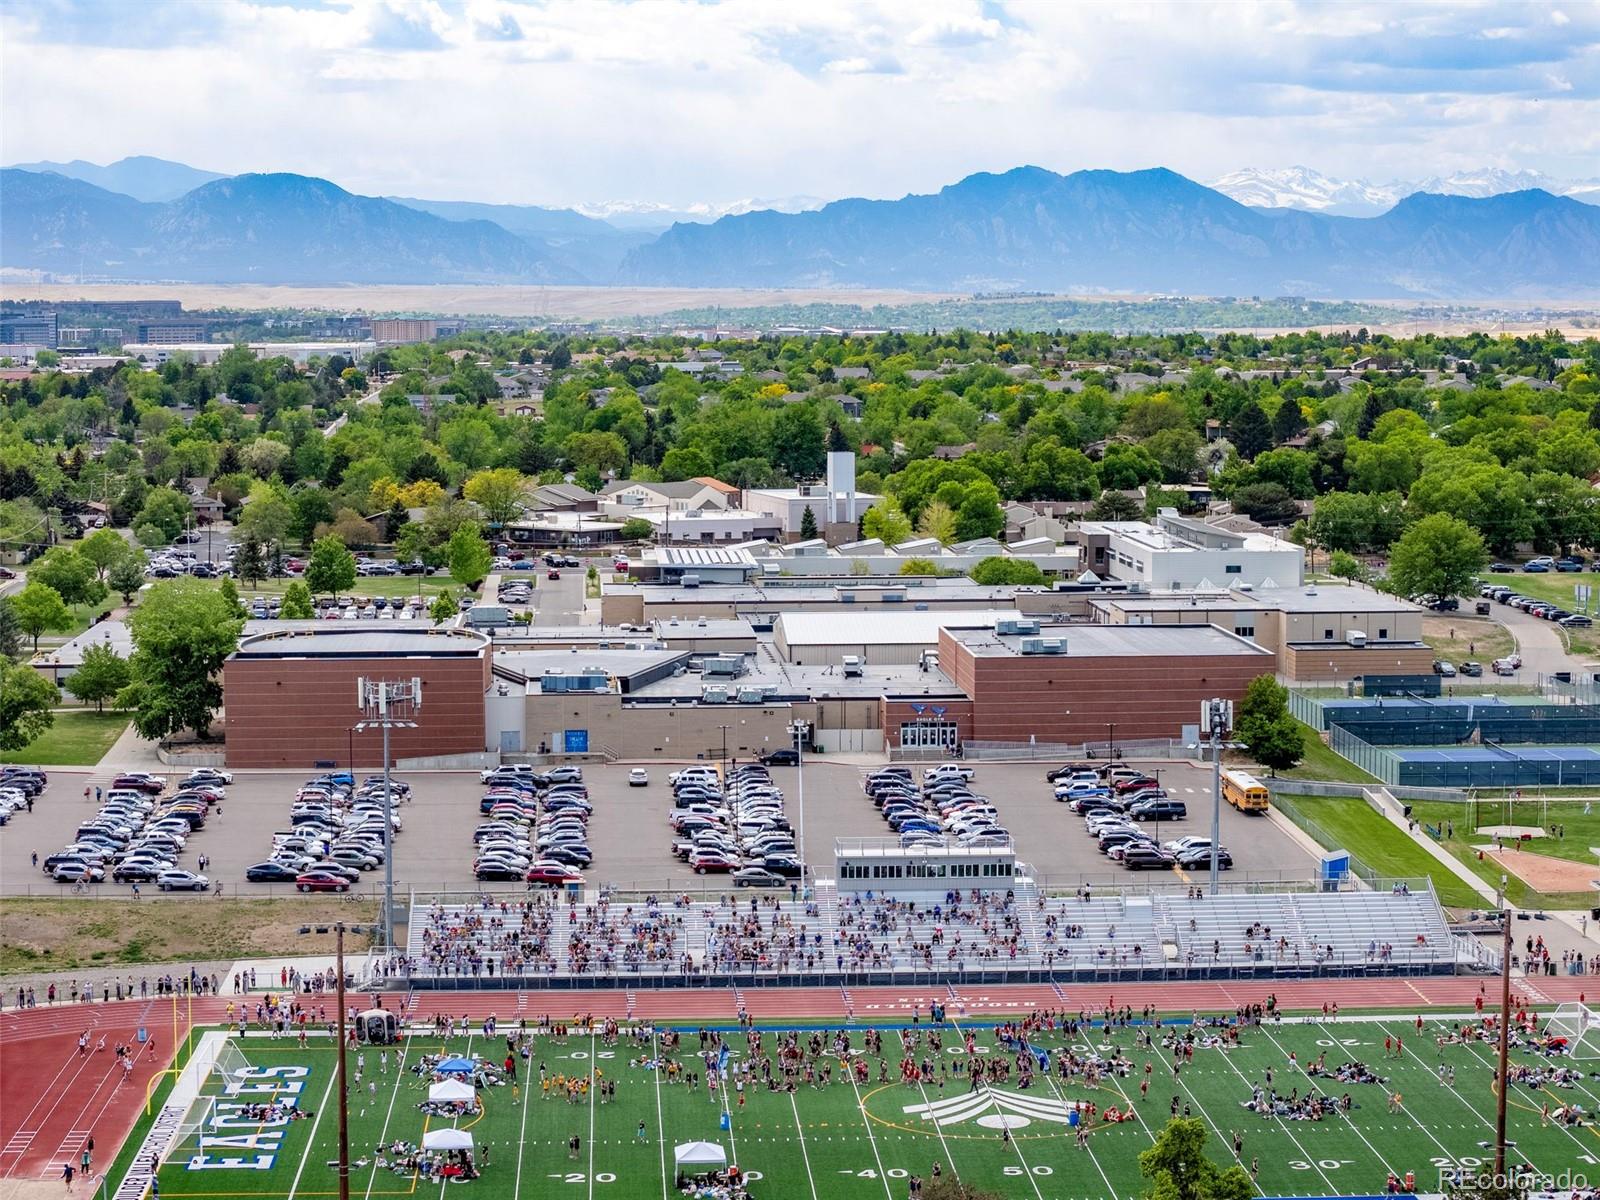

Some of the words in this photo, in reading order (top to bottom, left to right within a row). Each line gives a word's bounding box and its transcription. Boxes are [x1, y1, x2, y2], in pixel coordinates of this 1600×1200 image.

[1288, 1160, 1340, 1170] 30
[857, 1168, 909, 1178] 40
[1003, 1166, 1053, 1175] 50
[564, 1172, 617, 1183] 20
